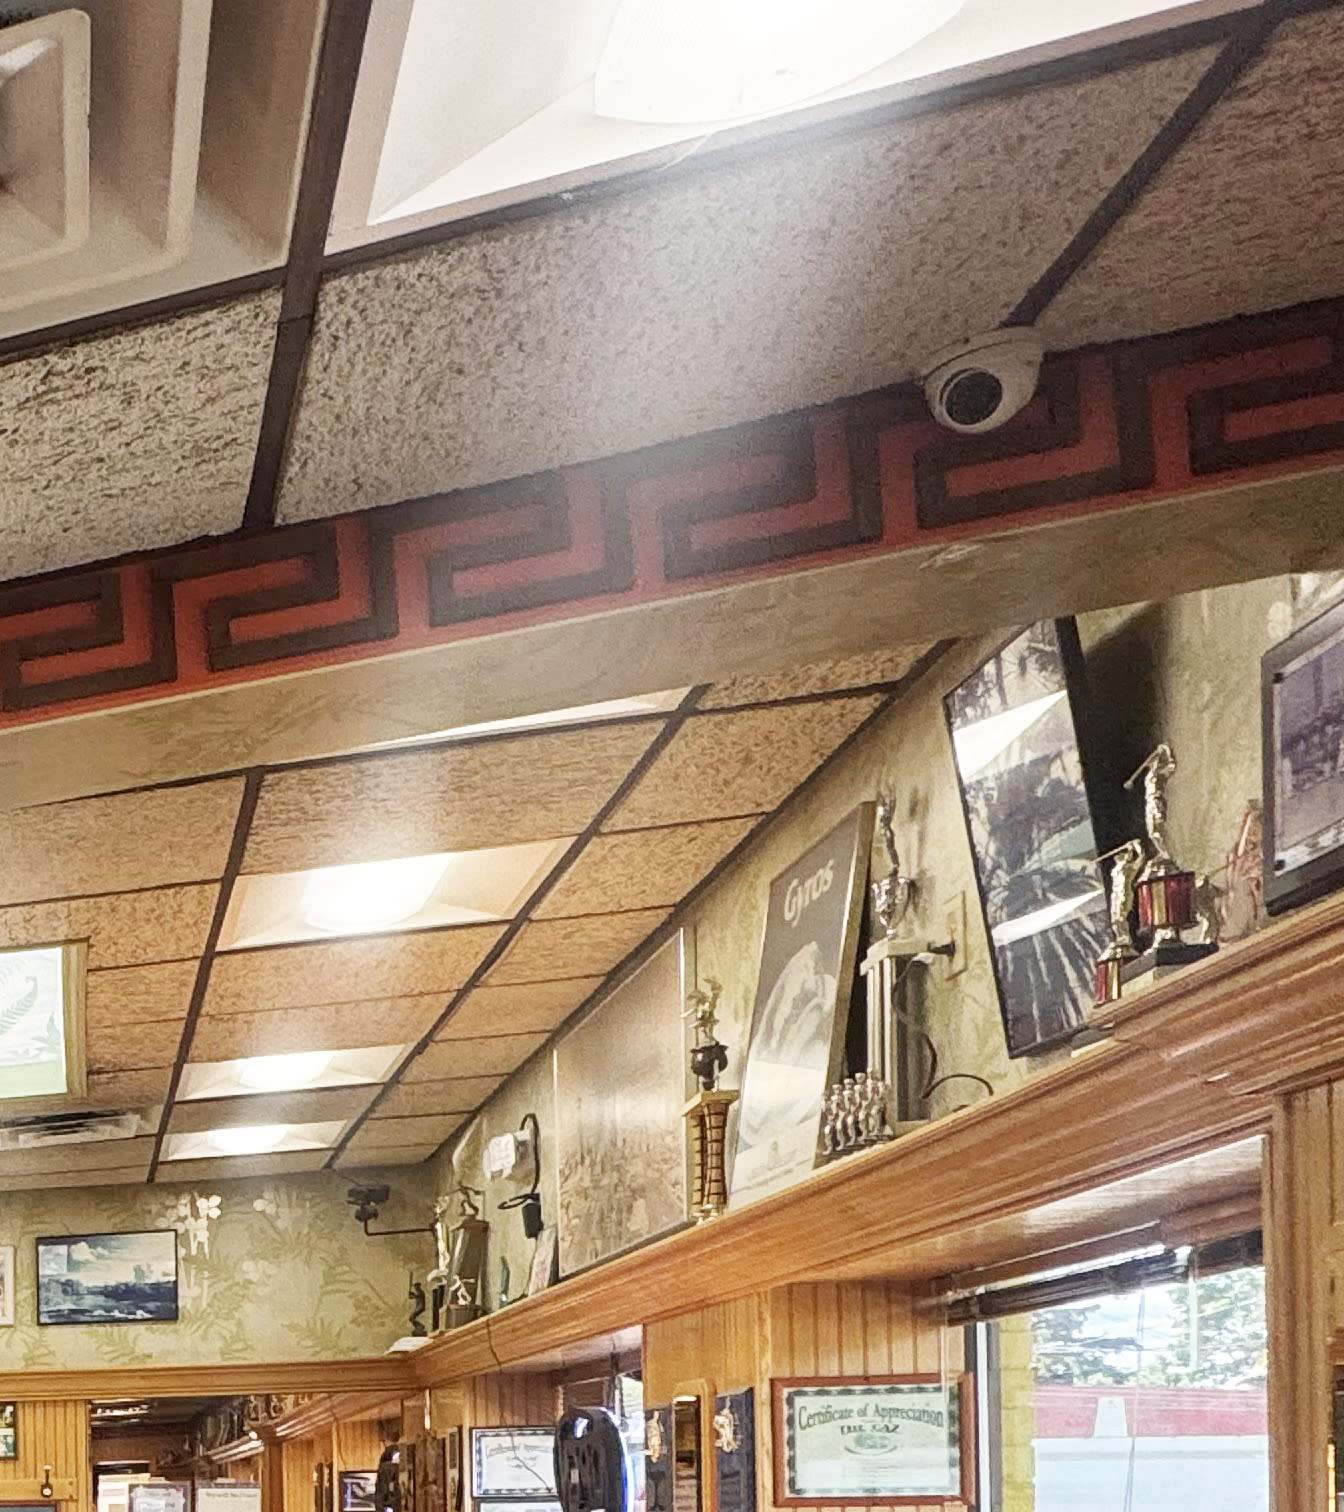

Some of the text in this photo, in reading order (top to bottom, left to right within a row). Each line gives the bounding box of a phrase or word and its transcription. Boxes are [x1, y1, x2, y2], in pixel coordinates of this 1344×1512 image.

[783, 859, 835, 929] Gyros
[798, 1402, 944, 1431] Certificate of Appreciation
